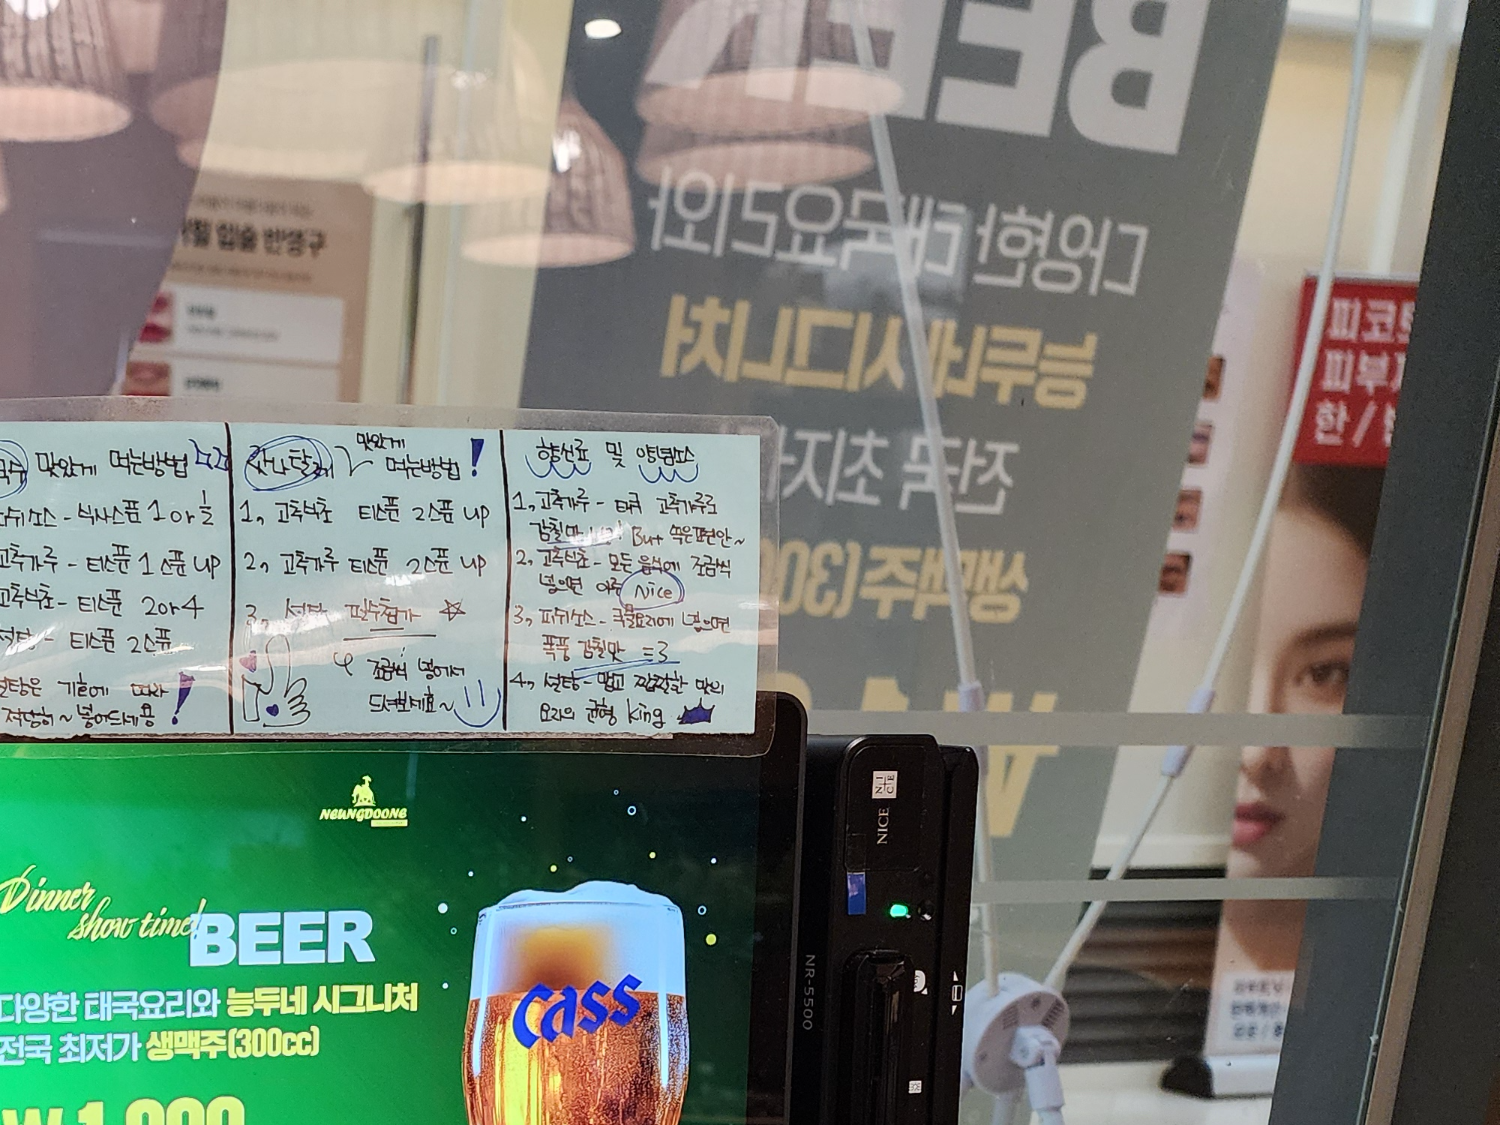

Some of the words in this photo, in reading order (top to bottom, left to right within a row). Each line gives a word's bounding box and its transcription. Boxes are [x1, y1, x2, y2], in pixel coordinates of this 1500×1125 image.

[535, 437, 590, 463] 향신료
[631, 525, 664, 547] But
[608, 553, 633, 574] 모든
[876, 806, 891, 845] NICE
[67, 898, 139, 941] show
[188, 909, 377, 969] BEER
[83, 988, 221, 1023] 태국요리와
[226, 985, 308, 1019] 능두네
[313, 982, 419, 1016] 시그니처
[802, 954, 815, 1032] NR-5500
[58, 1031, 142, 1065] 최저가
[146, 1025, 320, 1062] 생맥주(300cc)
